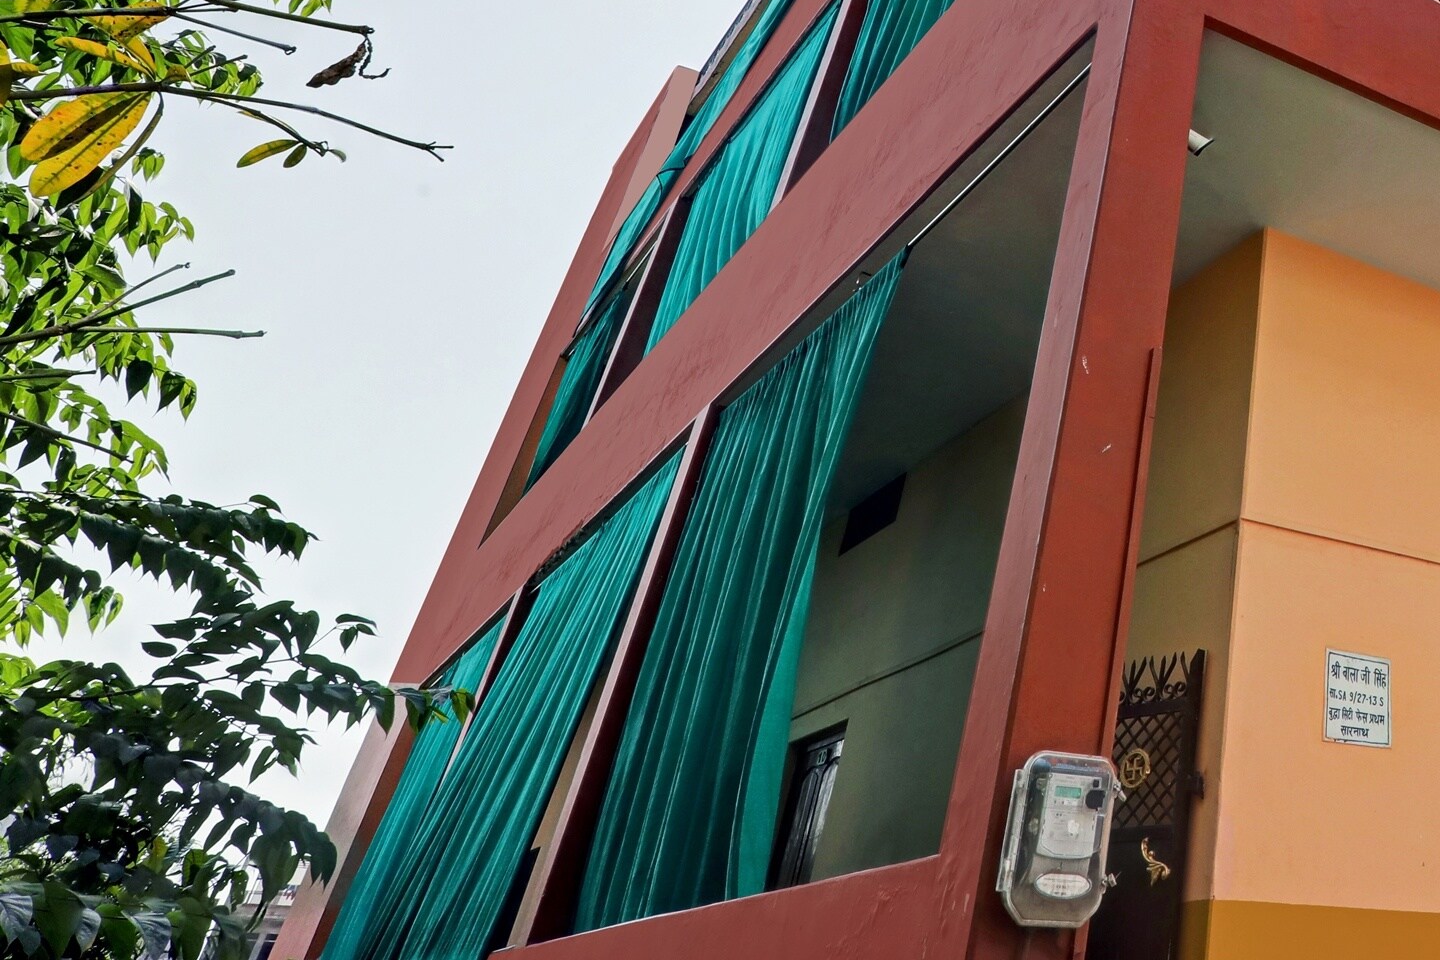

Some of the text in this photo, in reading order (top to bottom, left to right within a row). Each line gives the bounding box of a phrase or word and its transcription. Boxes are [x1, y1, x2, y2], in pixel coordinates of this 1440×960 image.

[1360, 666, 1371, 685] जी
[1373, 668, 1387, 688] सिंह
[1349, 691, 1377, 706] 9/27-13
[1340, 725, 1369, 738] सारनाथ
